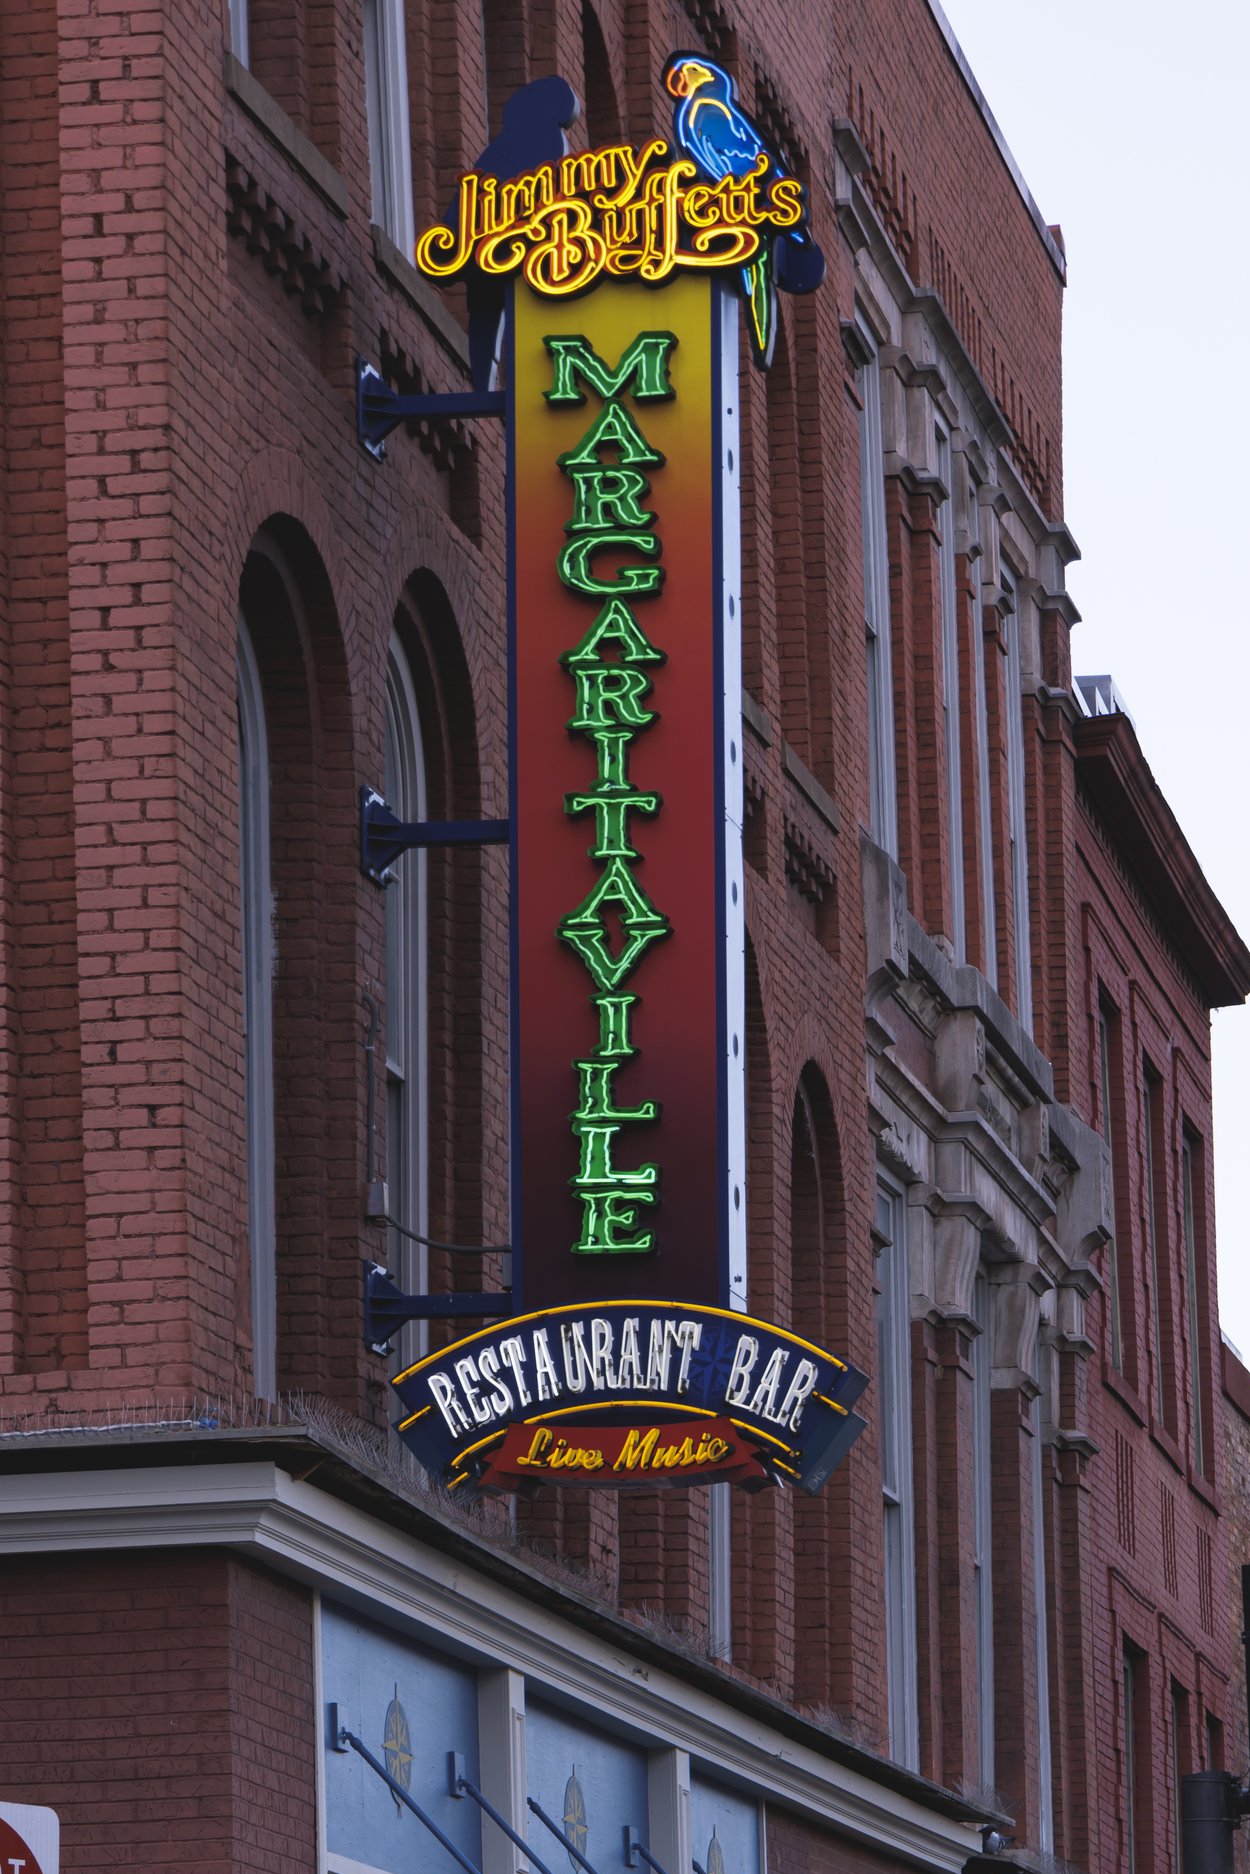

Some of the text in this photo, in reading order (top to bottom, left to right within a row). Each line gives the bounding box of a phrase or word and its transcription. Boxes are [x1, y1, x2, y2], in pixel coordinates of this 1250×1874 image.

[414, 138, 669, 276] Jimmy
[476, 151, 803, 295] Buffett's
[543, 330, 678, 1257] MARGARITAVILLE
[427, 1317, 819, 1439] RESTAURANT BAR
[516, 1427, 733, 1472] Live Music
